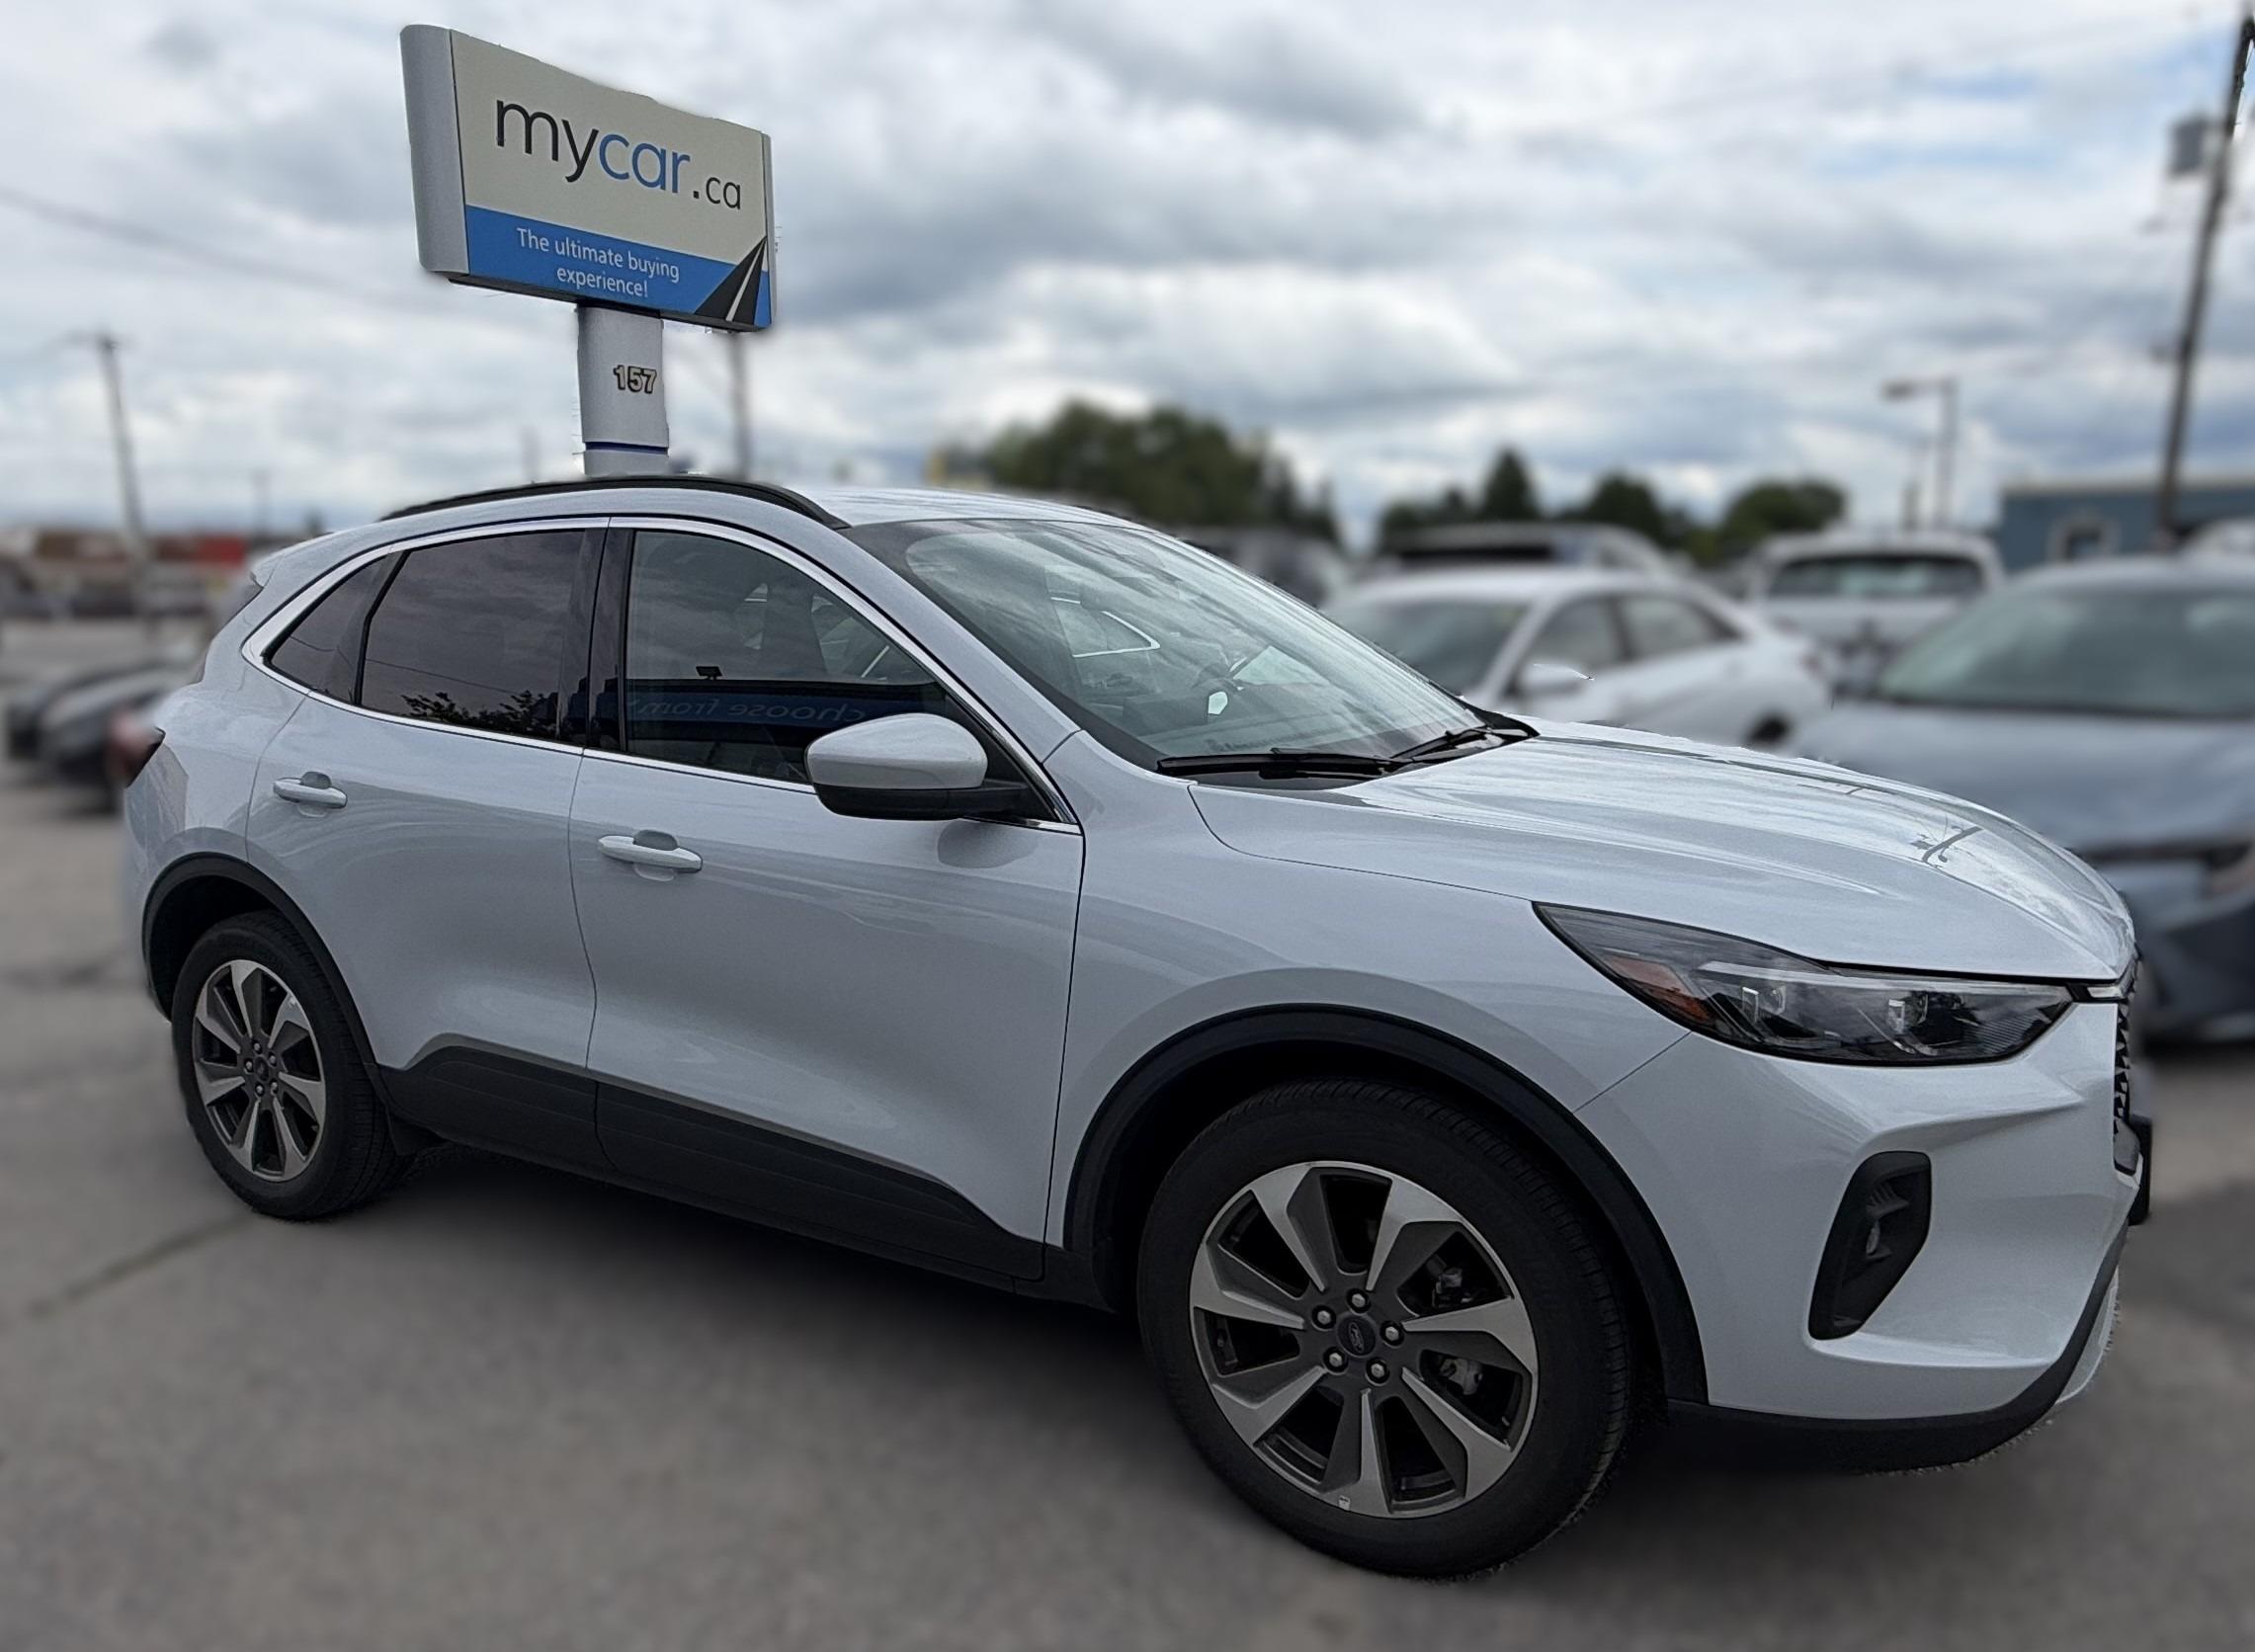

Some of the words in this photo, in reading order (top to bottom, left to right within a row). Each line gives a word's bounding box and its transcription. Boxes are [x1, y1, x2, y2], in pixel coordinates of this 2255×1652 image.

[496, 99, 742, 210] mycar.ca
[517, 227, 549, 252] The
[554, 237, 624, 268] ultimate
[627, 251, 680, 283] buying
[556, 267, 648, 297] experience!
[613, 365, 657, 394] 157
